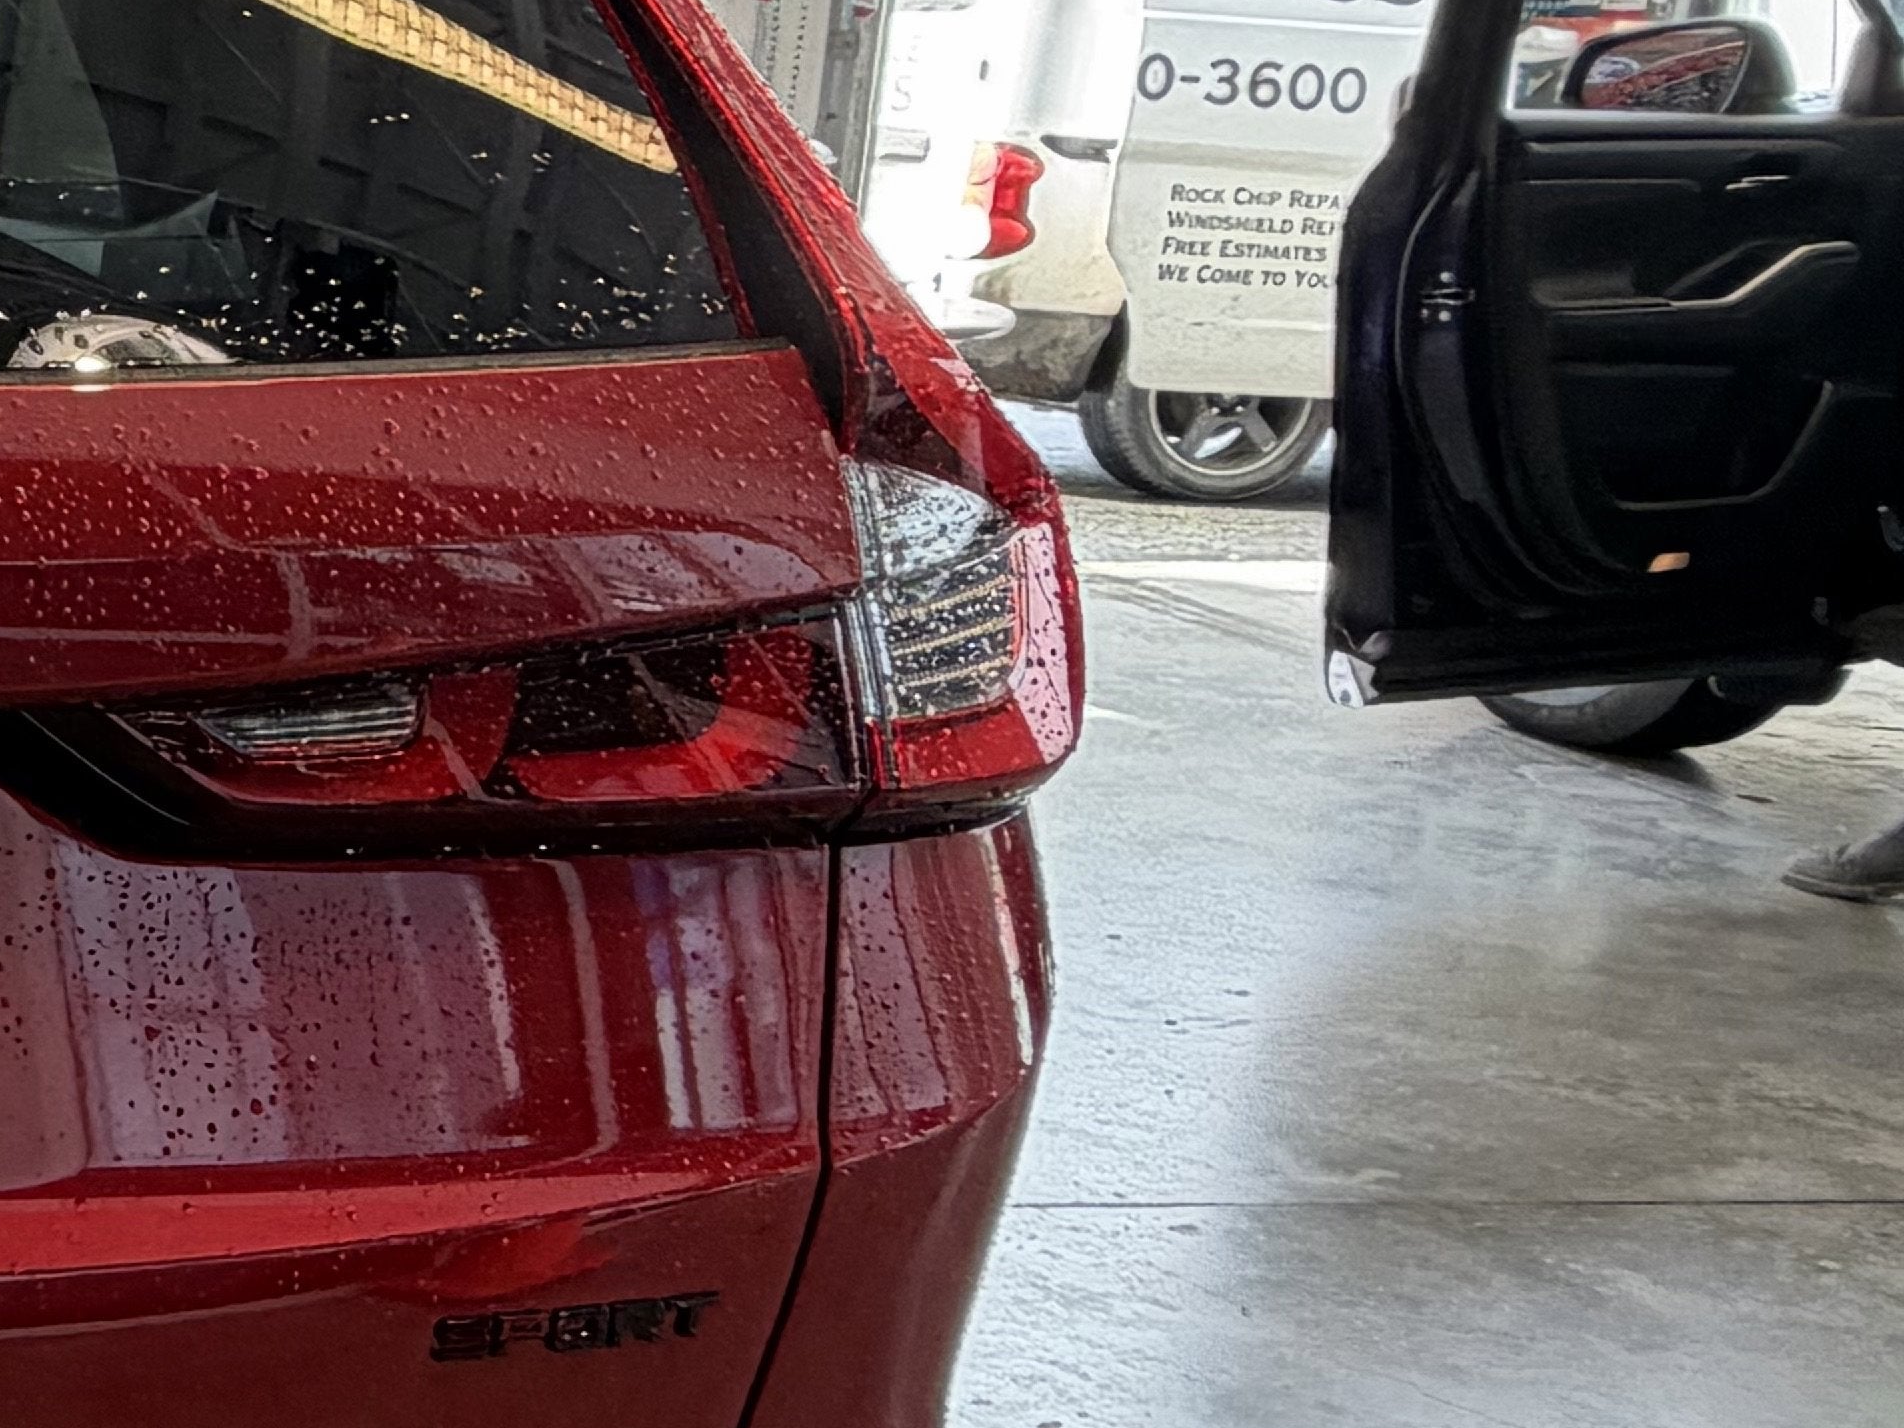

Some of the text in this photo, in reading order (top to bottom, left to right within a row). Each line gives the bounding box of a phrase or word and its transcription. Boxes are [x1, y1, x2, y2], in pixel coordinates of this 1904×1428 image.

[1137, 52, 1368, 114] 0-3600
[1170, 183, 1226, 204] ROCK
[1233, 187, 1282, 206] CHIP
[1167, 210, 1294, 234] WINDSHIELD
[1161, 236, 1328, 262] FREE ESTIMATES
[1157, 263, 1190, 282] WE
[1196, 264, 1253, 286] COME
[1261, 270, 1286, 287] TO
